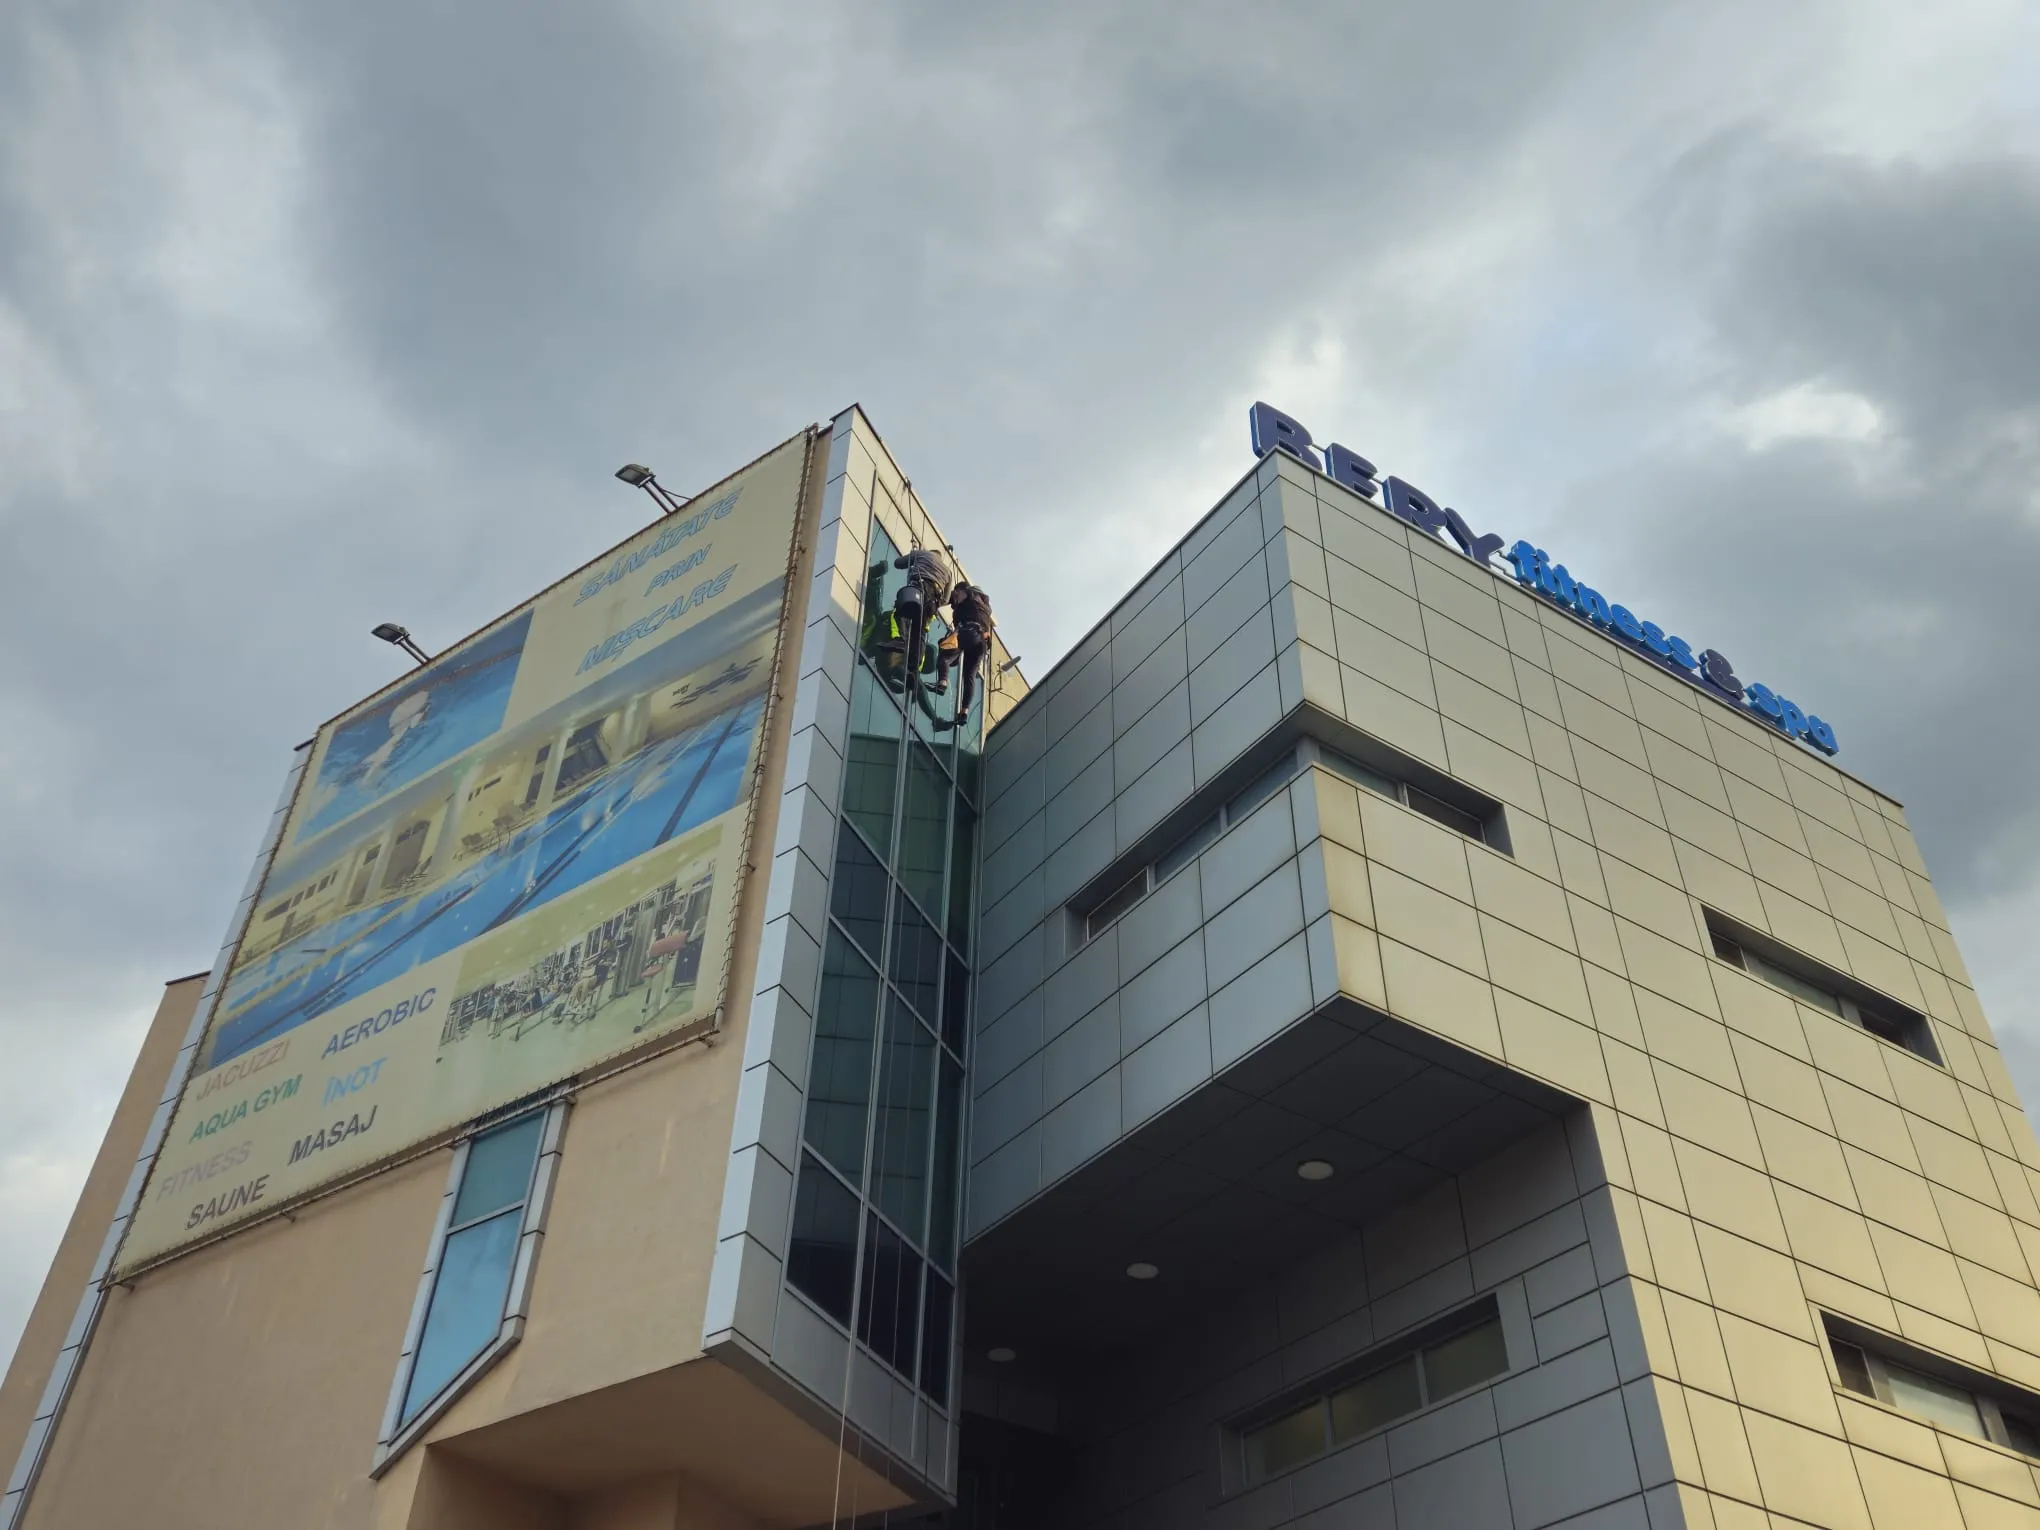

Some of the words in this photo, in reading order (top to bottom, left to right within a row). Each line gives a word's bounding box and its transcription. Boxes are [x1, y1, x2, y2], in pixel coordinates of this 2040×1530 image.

[1249, 401, 1505, 568] BERY
[1507, 540, 1697, 671] fitness
[643, 543, 713, 597] PRIN
[321, 987, 437, 1060] AEROBIC
[196, 1039, 290, 1100] JACUZZI
[189, 1105, 247, 1144] AQUA
[252, 1073, 303, 1113] GYM
[287, 1105, 378, 1166] MASAJ
[156, 1140, 253, 1201] FITNESS
[185, 1174, 270, 1230] SAUNE
